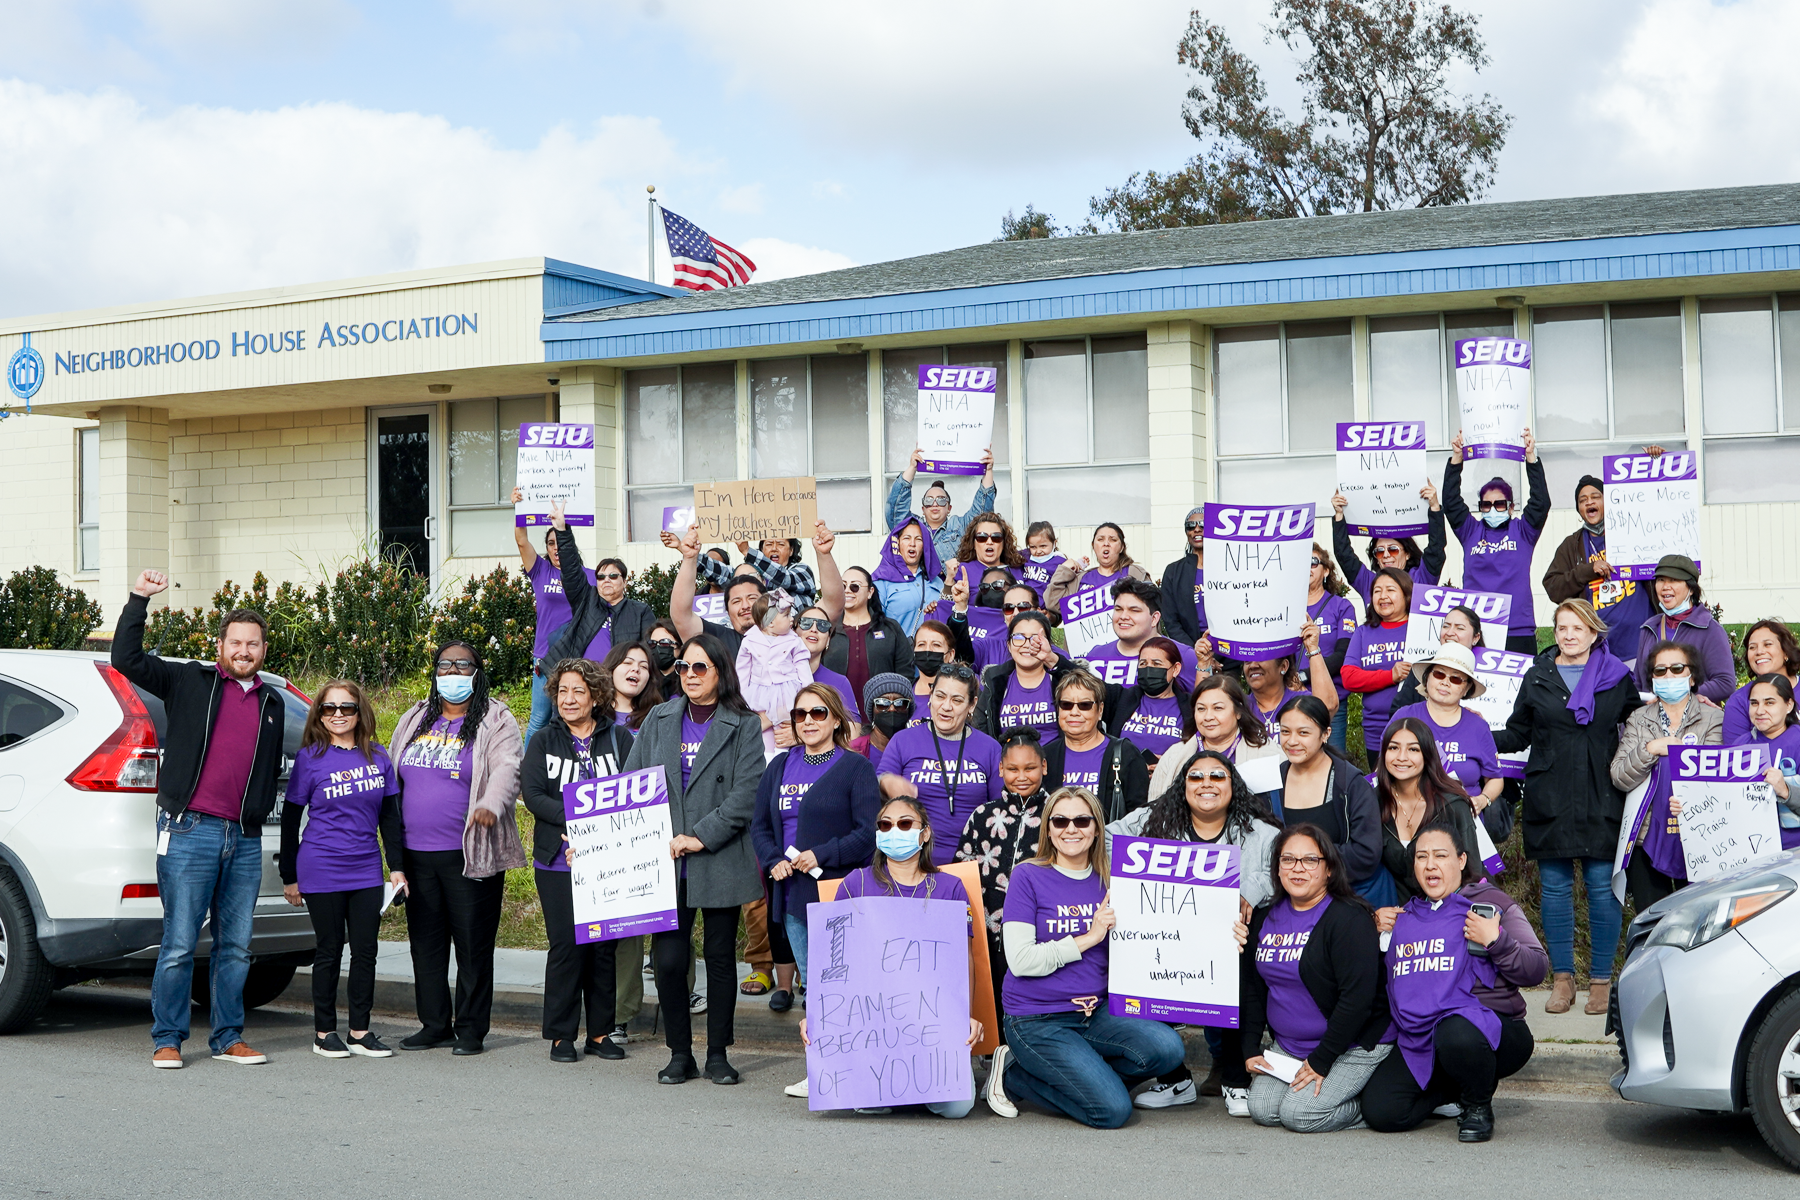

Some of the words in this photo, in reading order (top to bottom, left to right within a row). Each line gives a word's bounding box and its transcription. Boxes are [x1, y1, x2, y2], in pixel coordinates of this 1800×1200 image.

[55, 339, 220, 376] NEIGHBORHOOD
[231, 329, 306, 357] HOUSE
[317, 312, 478, 349] ASSOCIATION
[1460, 340, 1527, 364] SEIU
[924, 367, 991, 389] SEIU
[1466, 367, 1512, 392] NHA
[929, 393, 968, 412] NHA
[1487, 402, 1521, 411] contract
[923, 418, 940, 430] fair
[947, 422, 983, 430] contract
[1473, 416, 1500, 432] now!
[524, 425, 589, 446] SEIU
[936, 432, 959, 447] now!
[1344, 424, 1419, 448] SEIU
[519, 452, 539, 463] Make
[545, 449, 573, 462] NHA
[1360, 451, 1399, 471] NHA
[558, 463, 586, 477] priority!
[1611, 454, 1689, 481] SEIU
[529, 482, 554, 490] deserve
[559, 482, 581, 491] respect
[1339, 482, 1364, 492] Exceso
[1384, 482, 1410, 491] trabajo
[697, 489, 733, 509] I'm
[743, 486, 775, 505] Here
[1610, 488, 1646, 505] Give
[1657, 487, 1690, 502] More
[1372, 506, 1388, 515] mal
[697, 514, 720, 538] my
[724, 513, 773, 532] teachers
[777, 514, 800, 526] are
[1213, 507, 1310, 537] SEIU
[722, 529, 767, 542] WORTH
[1611, 545, 1626, 554] I
[1633, 539, 1669, 553] need
[1225, 542, 1282, 572] NHA
[543, 584, 562, 594] THE
[1419, 589, 1504, 620] SEIU
[975, 627, 987, 638] IS
[1367, 641, 1398, 654] NOW
[1360, 654, 1382, 668] THE
[1001, 702, 1033, 715] NOW
[1034, 701, 1048, 712] IS
[1019, 711, 1057, 727] TIME!
[1131, 711, 1162, 725] NOW
[1163, 714, 1177, 727] IS
[1150, 723, 1183, 739] TIME!
[1445, 741, 1459, 752] IS
[401, 757, 431, 768] PEOPLE
[922, 759, 958, 771] NOW
[1679, 748, 1761, 778] SEIU
[330, 766, 364, 784] NOW
[366, 764, 380, 776] IS
[910, 771, 942, 783] THE
[1083, 771, 1099, 783] IS
[323, 781, 353, 800] THE
[574, 772, 657, 815] SEIU
[1682, 794, 1719, 821] Enough
[568, 823, 599, 840] Make
[610, 808, 646, 833] NHA
[574, 843, 609, 859] workers
[630, 821, 665, 848] priority!
[1121, 841, 1231, 881] SEIU
[1687, 852, 1709, 870] Give
[1728, 837, 1738, 846] a
[573, 873, 587, 887] We
[597, 867, 627, 881] deserve
[633, 857, 660, 872] respect
[603, 887, 620, 899] fair
[1141, 882, 1197, 916] NHA
[1057, 903, 1093, 918] NOW
[1046, 918, 1080, 934] THE
[821, 912, 855, 984] I
[881, 937, 950, 973] EAT
[1261, 932, 1296, 947] NOW
[1294, 931, 1311, 945] IS
[1395, 940, 1428, 959] NOW
[1429, 938, 1445, 954] IS
[1413, 956, 1455, 973] TIME!
[818, 986, 940, 1030] RAMEN
[814, 1023, 940, 1058] BECAUSE
[818, 1068, 853, 1098] OF
[869, 1047, 961, 1101] YOU!!!
